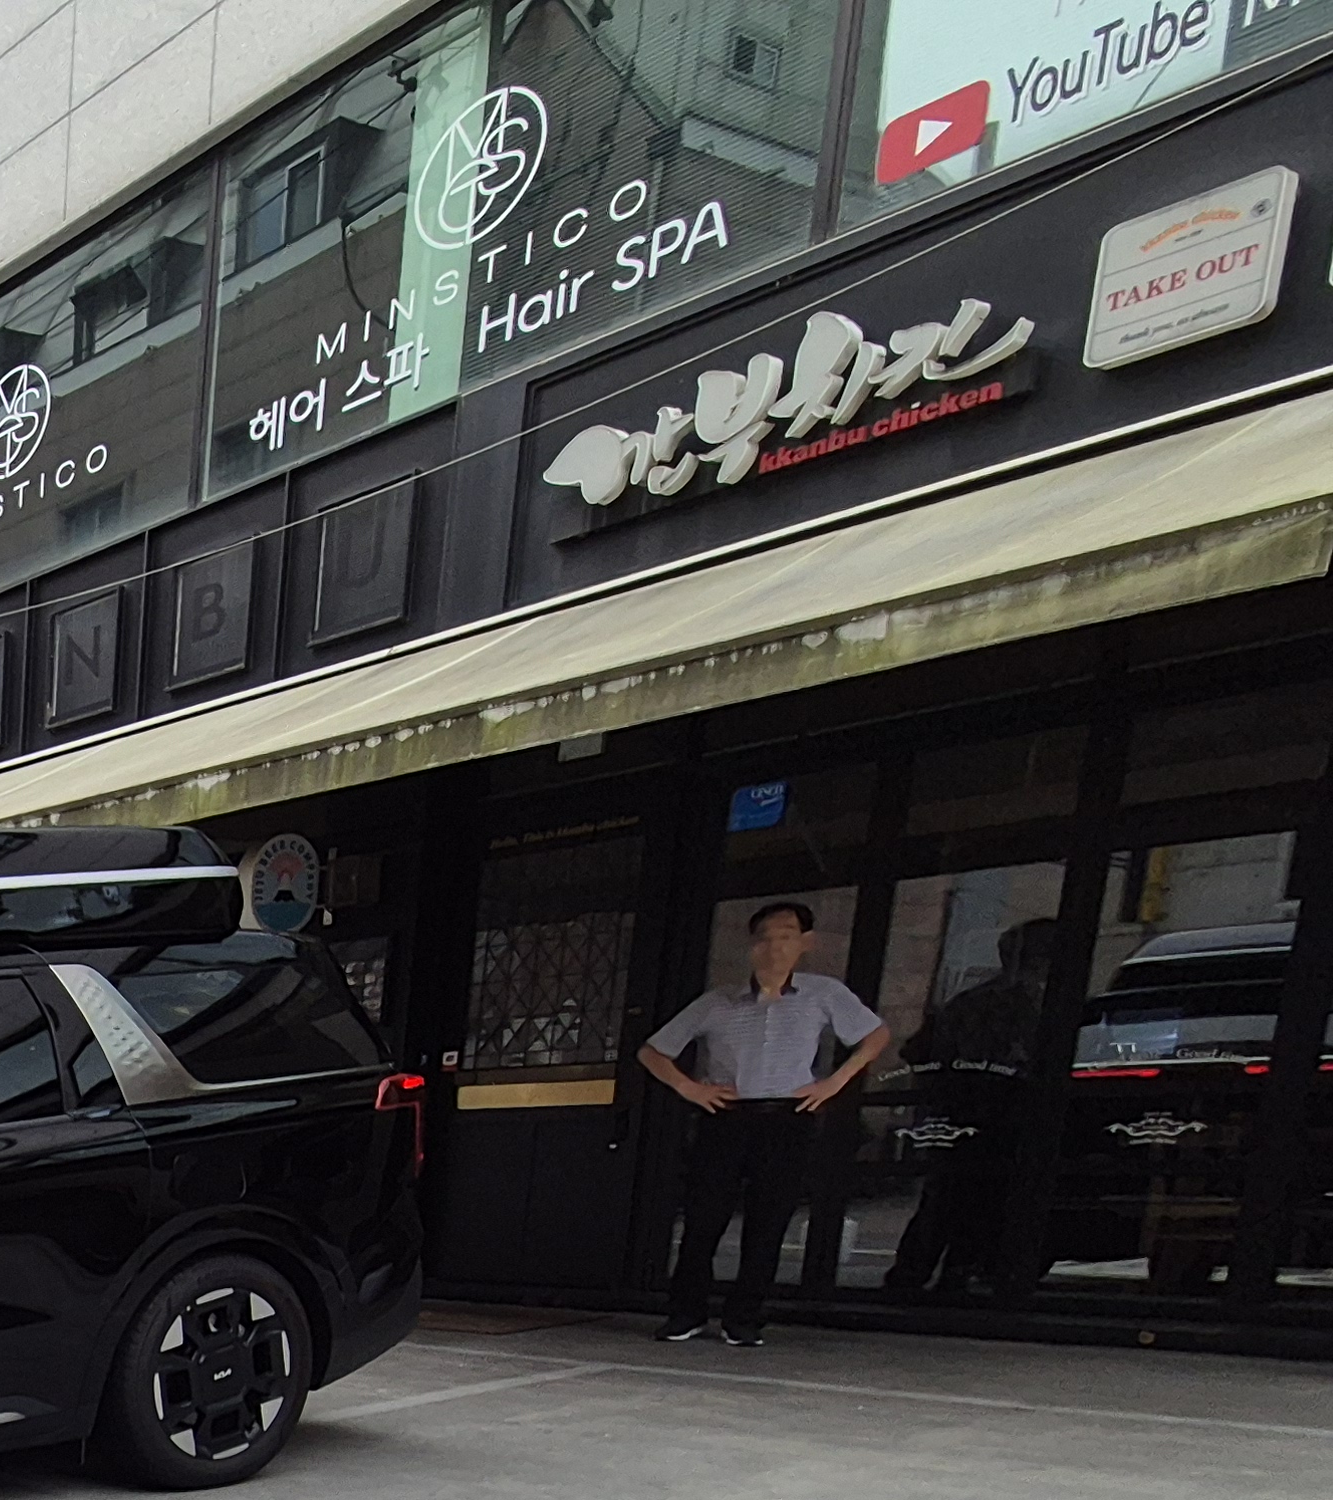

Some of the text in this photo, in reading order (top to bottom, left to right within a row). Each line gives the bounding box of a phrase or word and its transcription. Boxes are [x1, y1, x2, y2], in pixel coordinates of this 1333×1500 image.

[1006, 0, 1210, 124] YouTube
[248, 200, 730, 452] 헤어 스파 Hair SPA
[315, 178, 648, 364] MINSTICO
[1105, 243, 1260, 312] TAKE OUT
[543, 298, 1035, 507] 깐부치킨
[757, 381, 1004, 475] kkanbu chicken
